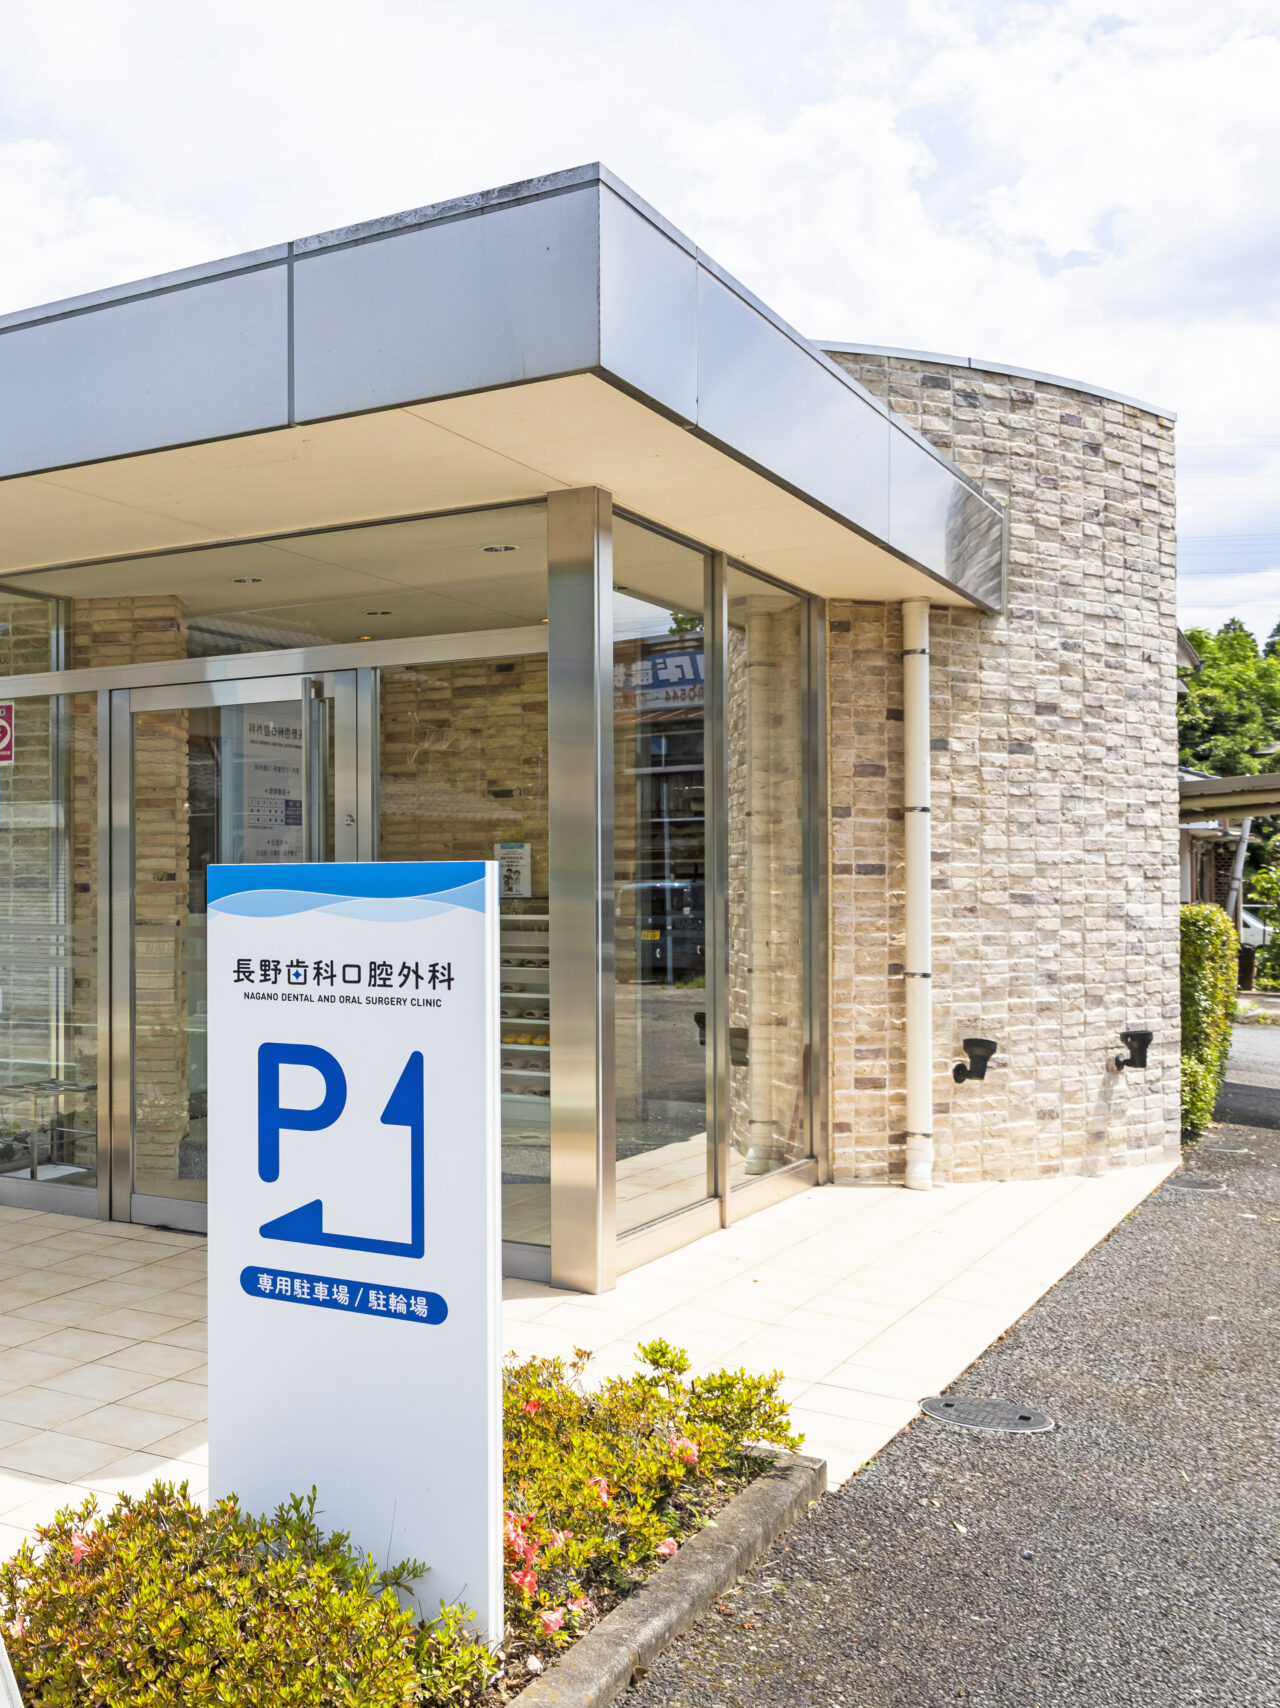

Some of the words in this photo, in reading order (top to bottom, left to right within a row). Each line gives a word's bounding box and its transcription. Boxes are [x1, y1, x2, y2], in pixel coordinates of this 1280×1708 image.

[233, 958, 455, 991] 長野歯科口腔外科
[243, 991, 279, 1002] NAGANO
[281, 993, 315, 1003] DENTAL
[317, 994, 336, 1004] AND
[338, 995, 363, 1005] ORAL
[365, 996, 408, 1007] SURGERY
[410, 998, 442, 1008] CLINIC
[257, 1042, 348, 1183] P
